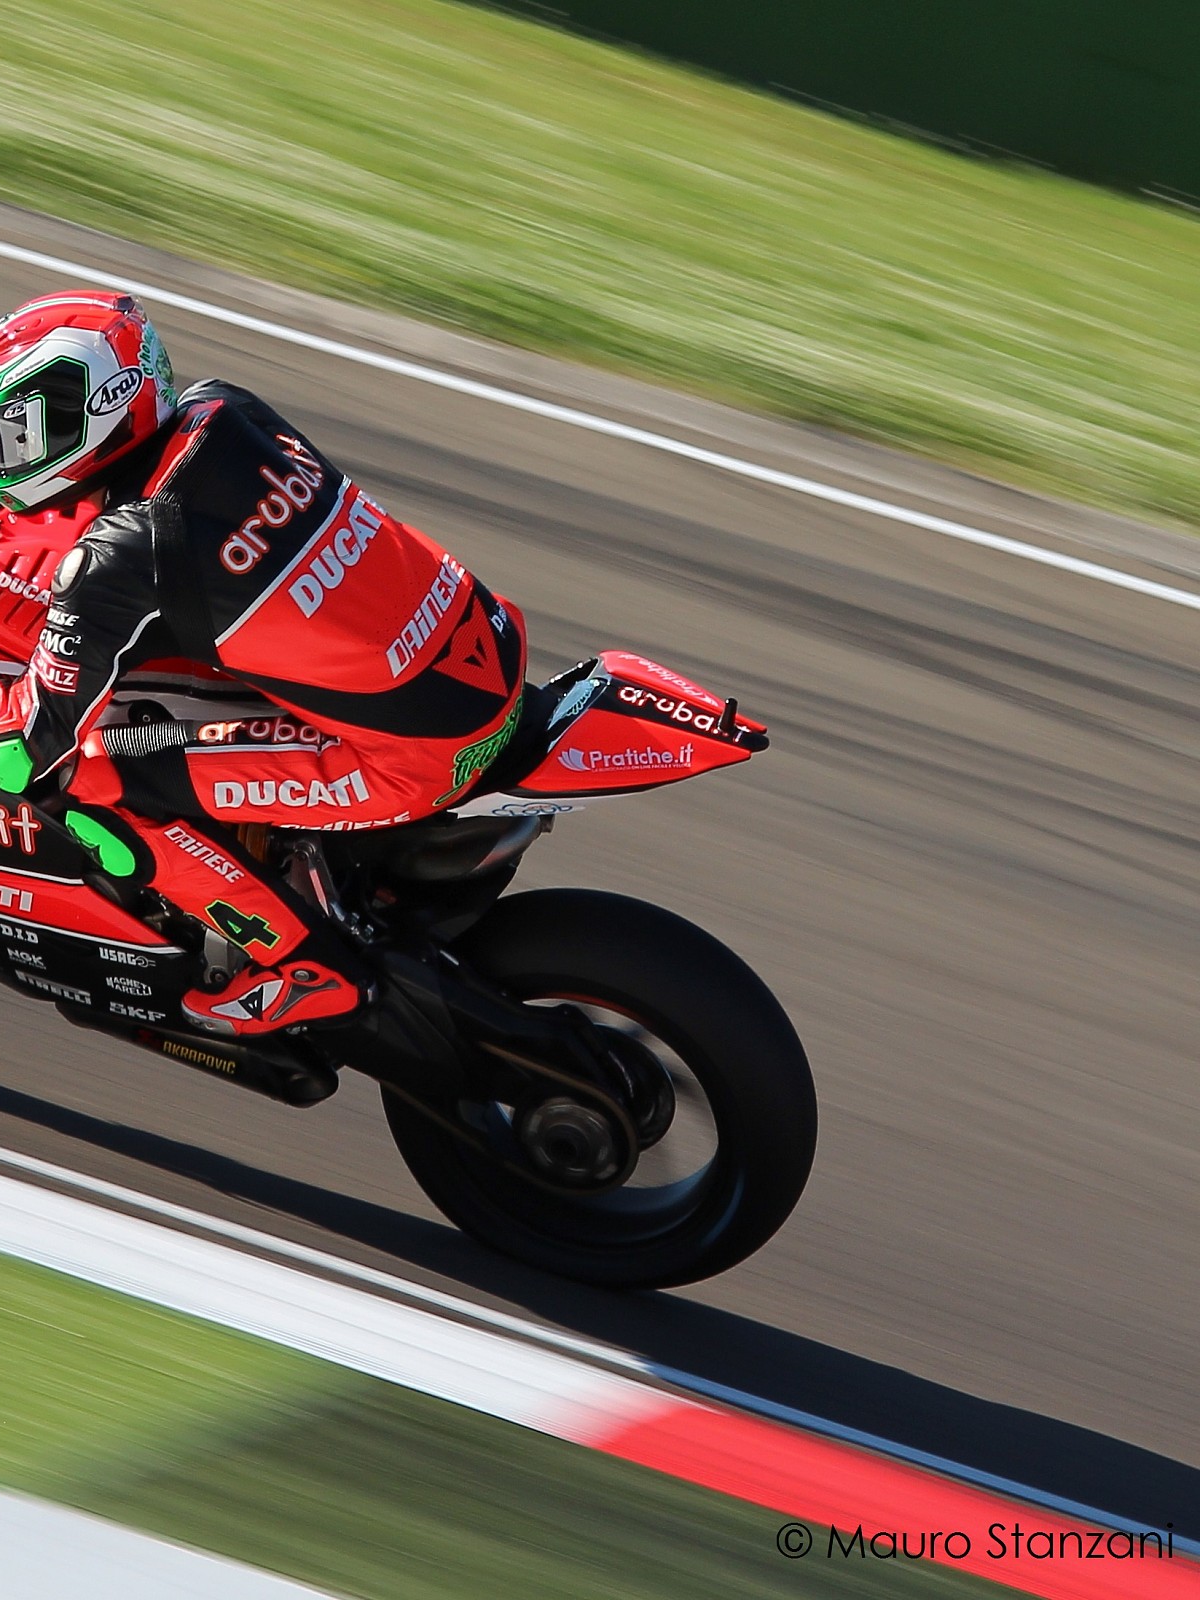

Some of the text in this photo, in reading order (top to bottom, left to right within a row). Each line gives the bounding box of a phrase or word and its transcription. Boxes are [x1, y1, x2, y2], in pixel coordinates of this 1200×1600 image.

[94, 370, 138, 413] Arai
[288, 490, 388, 618] DUCATI
[617, 685, 751, 743] aruba.t
[589, 742, 694, 769] Pratiche.it
[214, 769, 370, 809] DUCATI
[204, 900, 281, 950] 4
[7, 948, 44, 966] NGK
[99, 947, 136, 966] USAG
[110, 1001, 166, 1021] SKF
